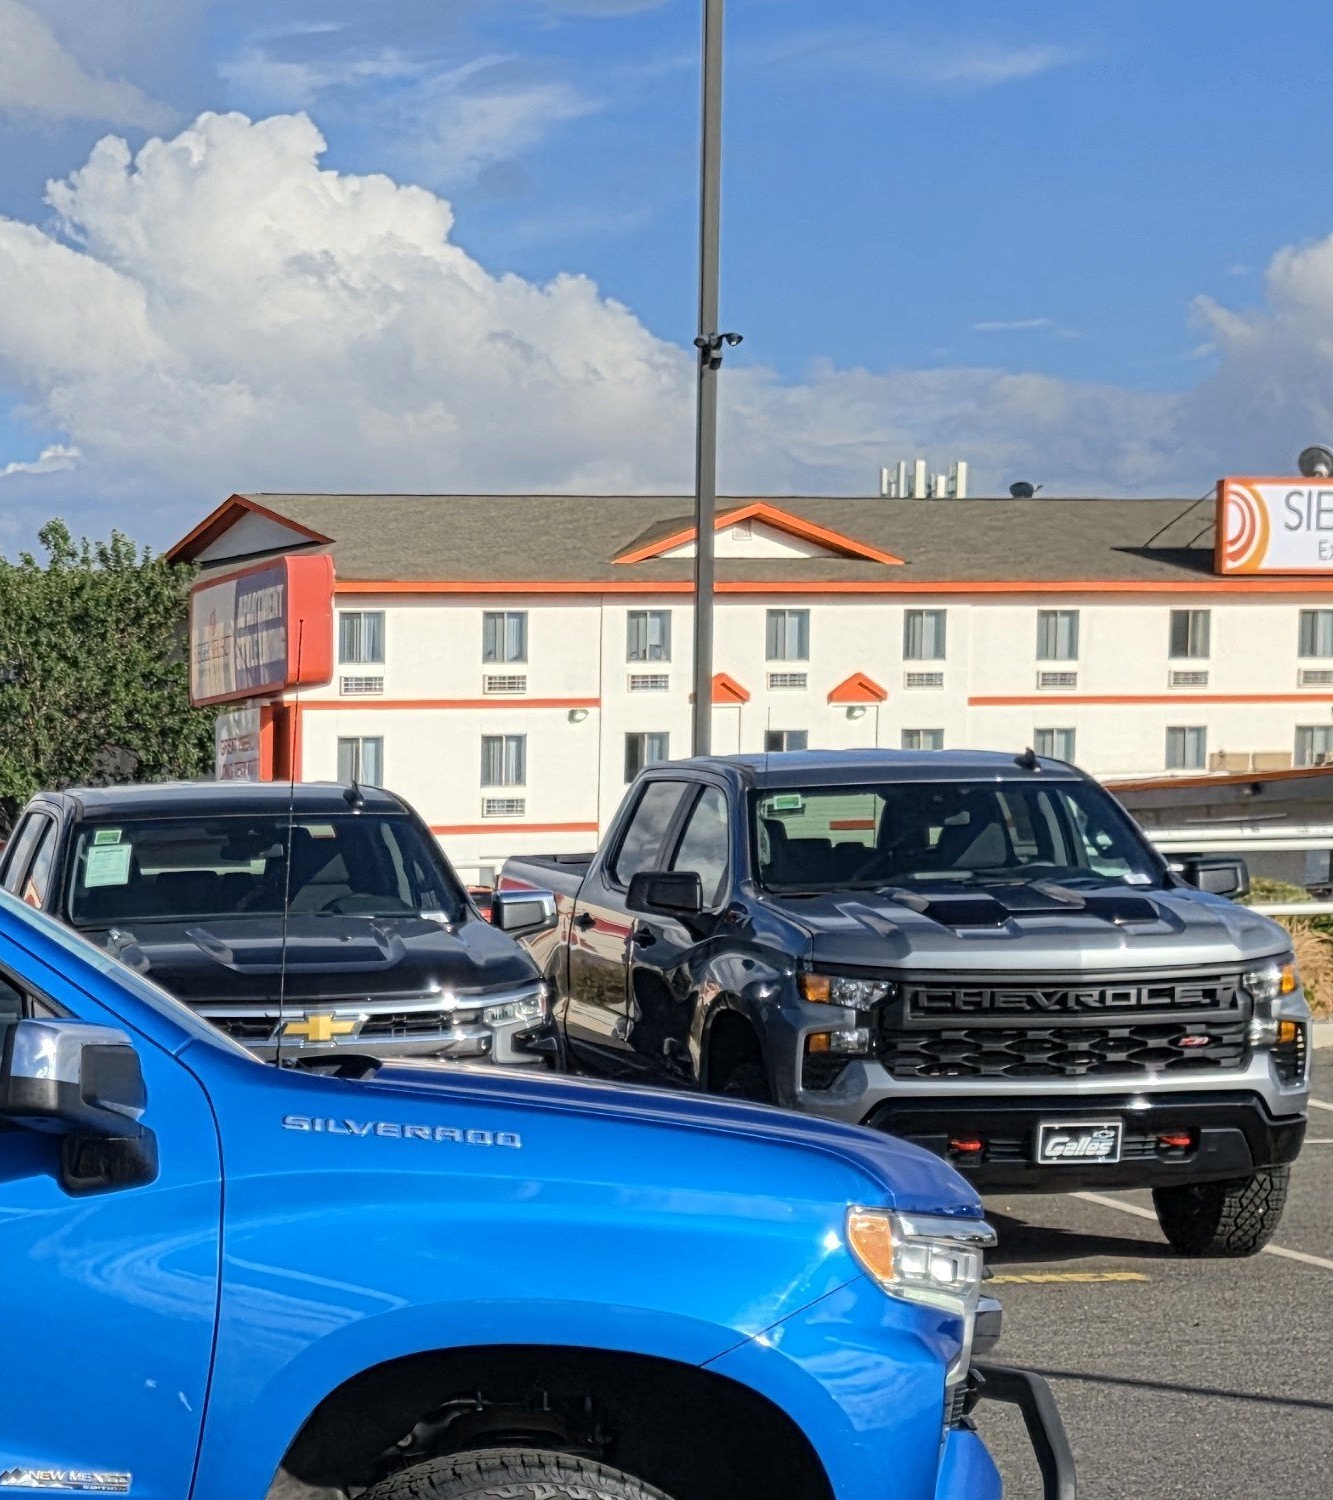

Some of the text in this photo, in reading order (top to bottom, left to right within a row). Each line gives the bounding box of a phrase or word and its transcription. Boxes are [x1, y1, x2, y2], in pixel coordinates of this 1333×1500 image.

[917, 986, 1237, 1011] CHEVROLET
[282, 1114, 522, 1149] SILVERADO
[30, 1470, 67, 1481] NEW
